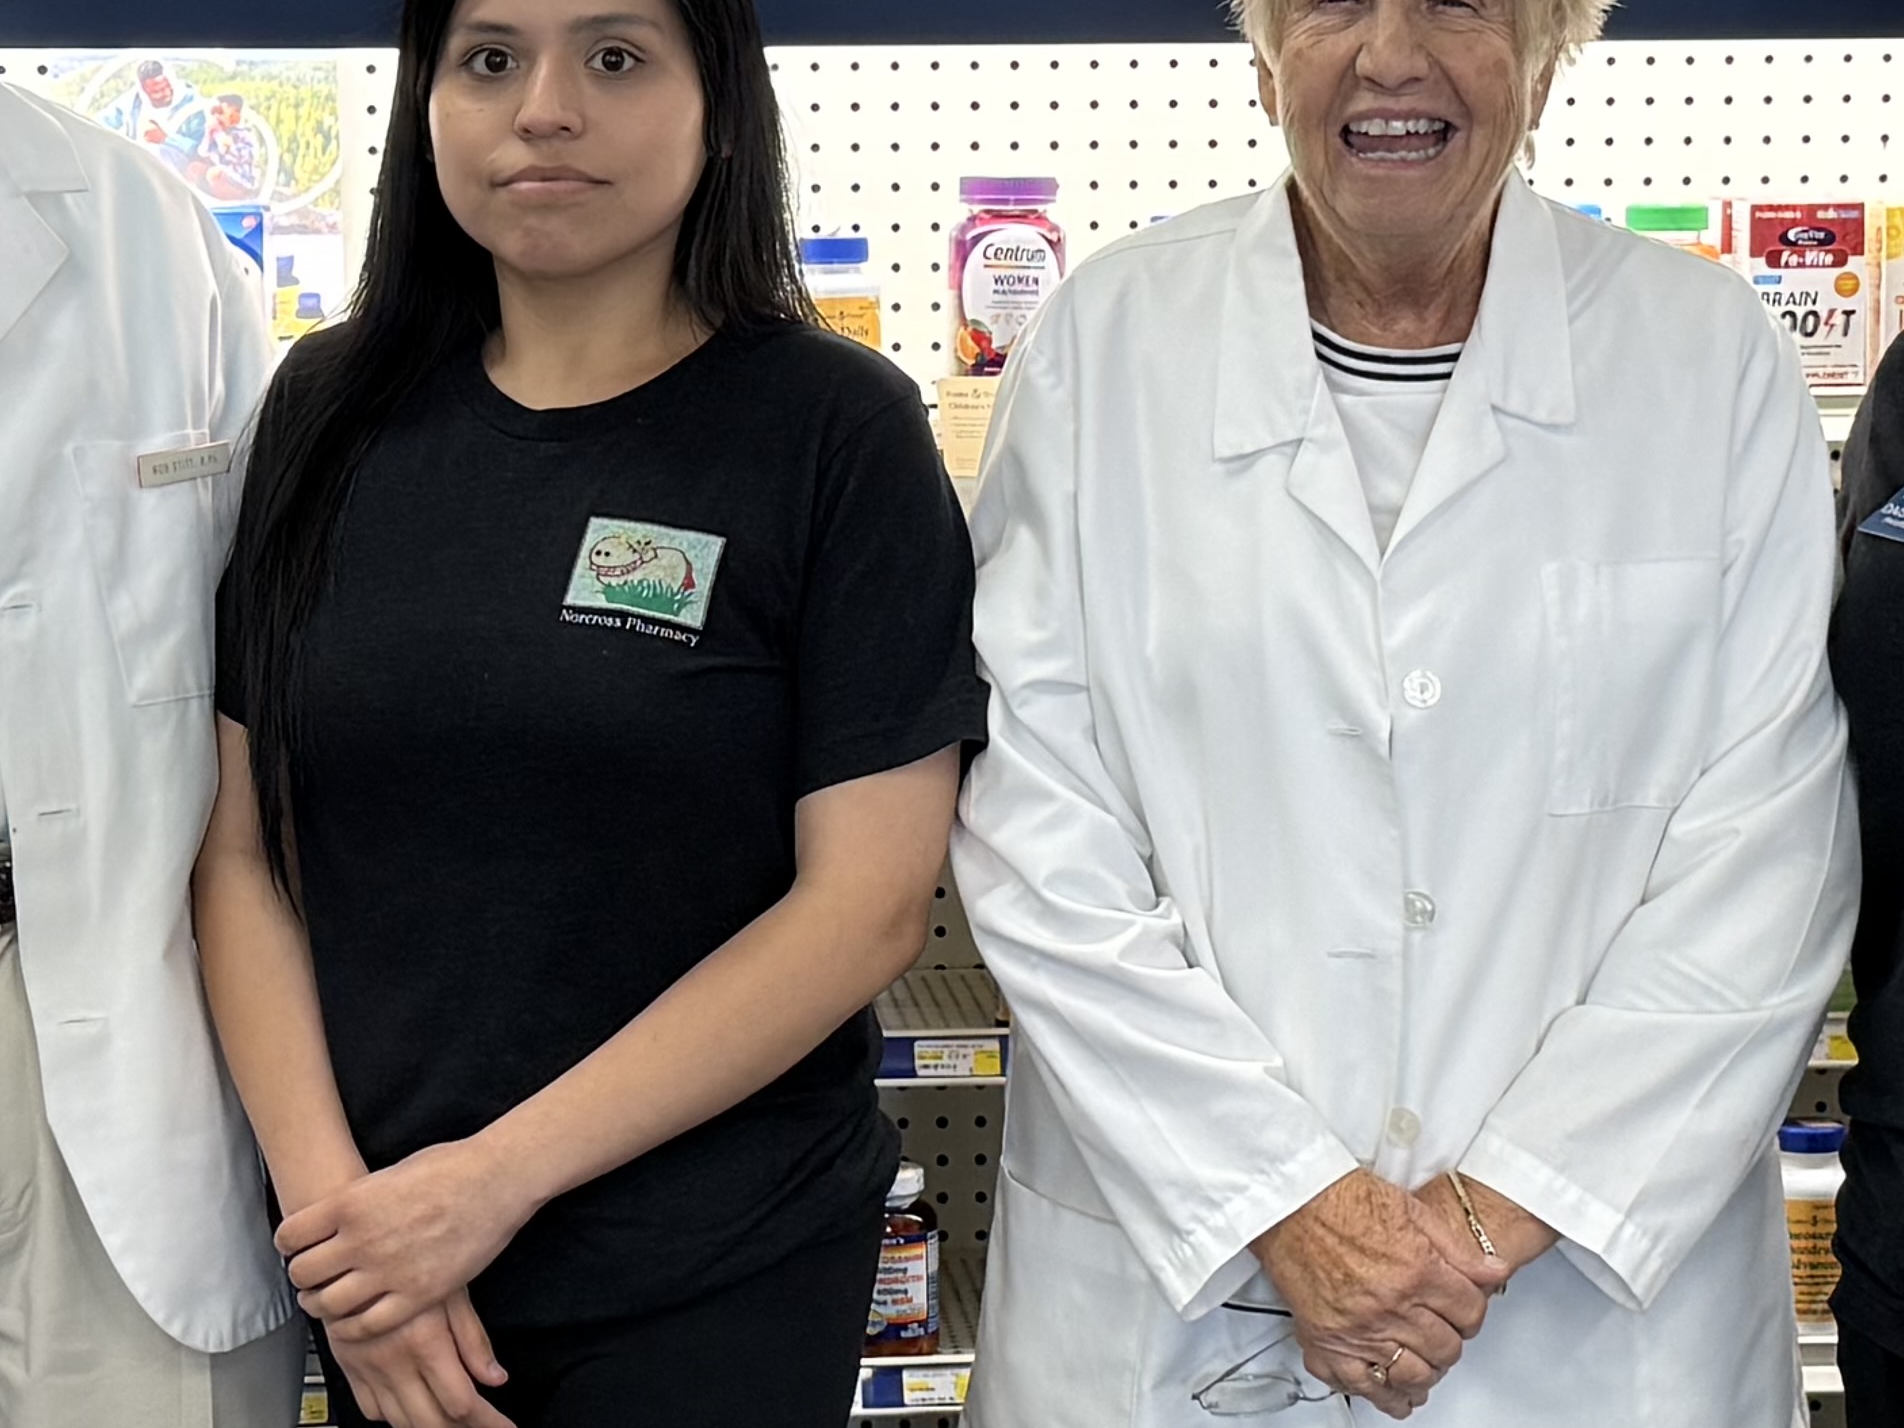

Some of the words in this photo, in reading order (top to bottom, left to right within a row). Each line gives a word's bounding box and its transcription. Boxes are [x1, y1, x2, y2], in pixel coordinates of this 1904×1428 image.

[983, 243, 1045, 262] Centrum
[993, 275, 1039, 287] WOMEN
[559, 609, 621, 627] Norcross
[626, 617, 699, 647] Pharmacy
